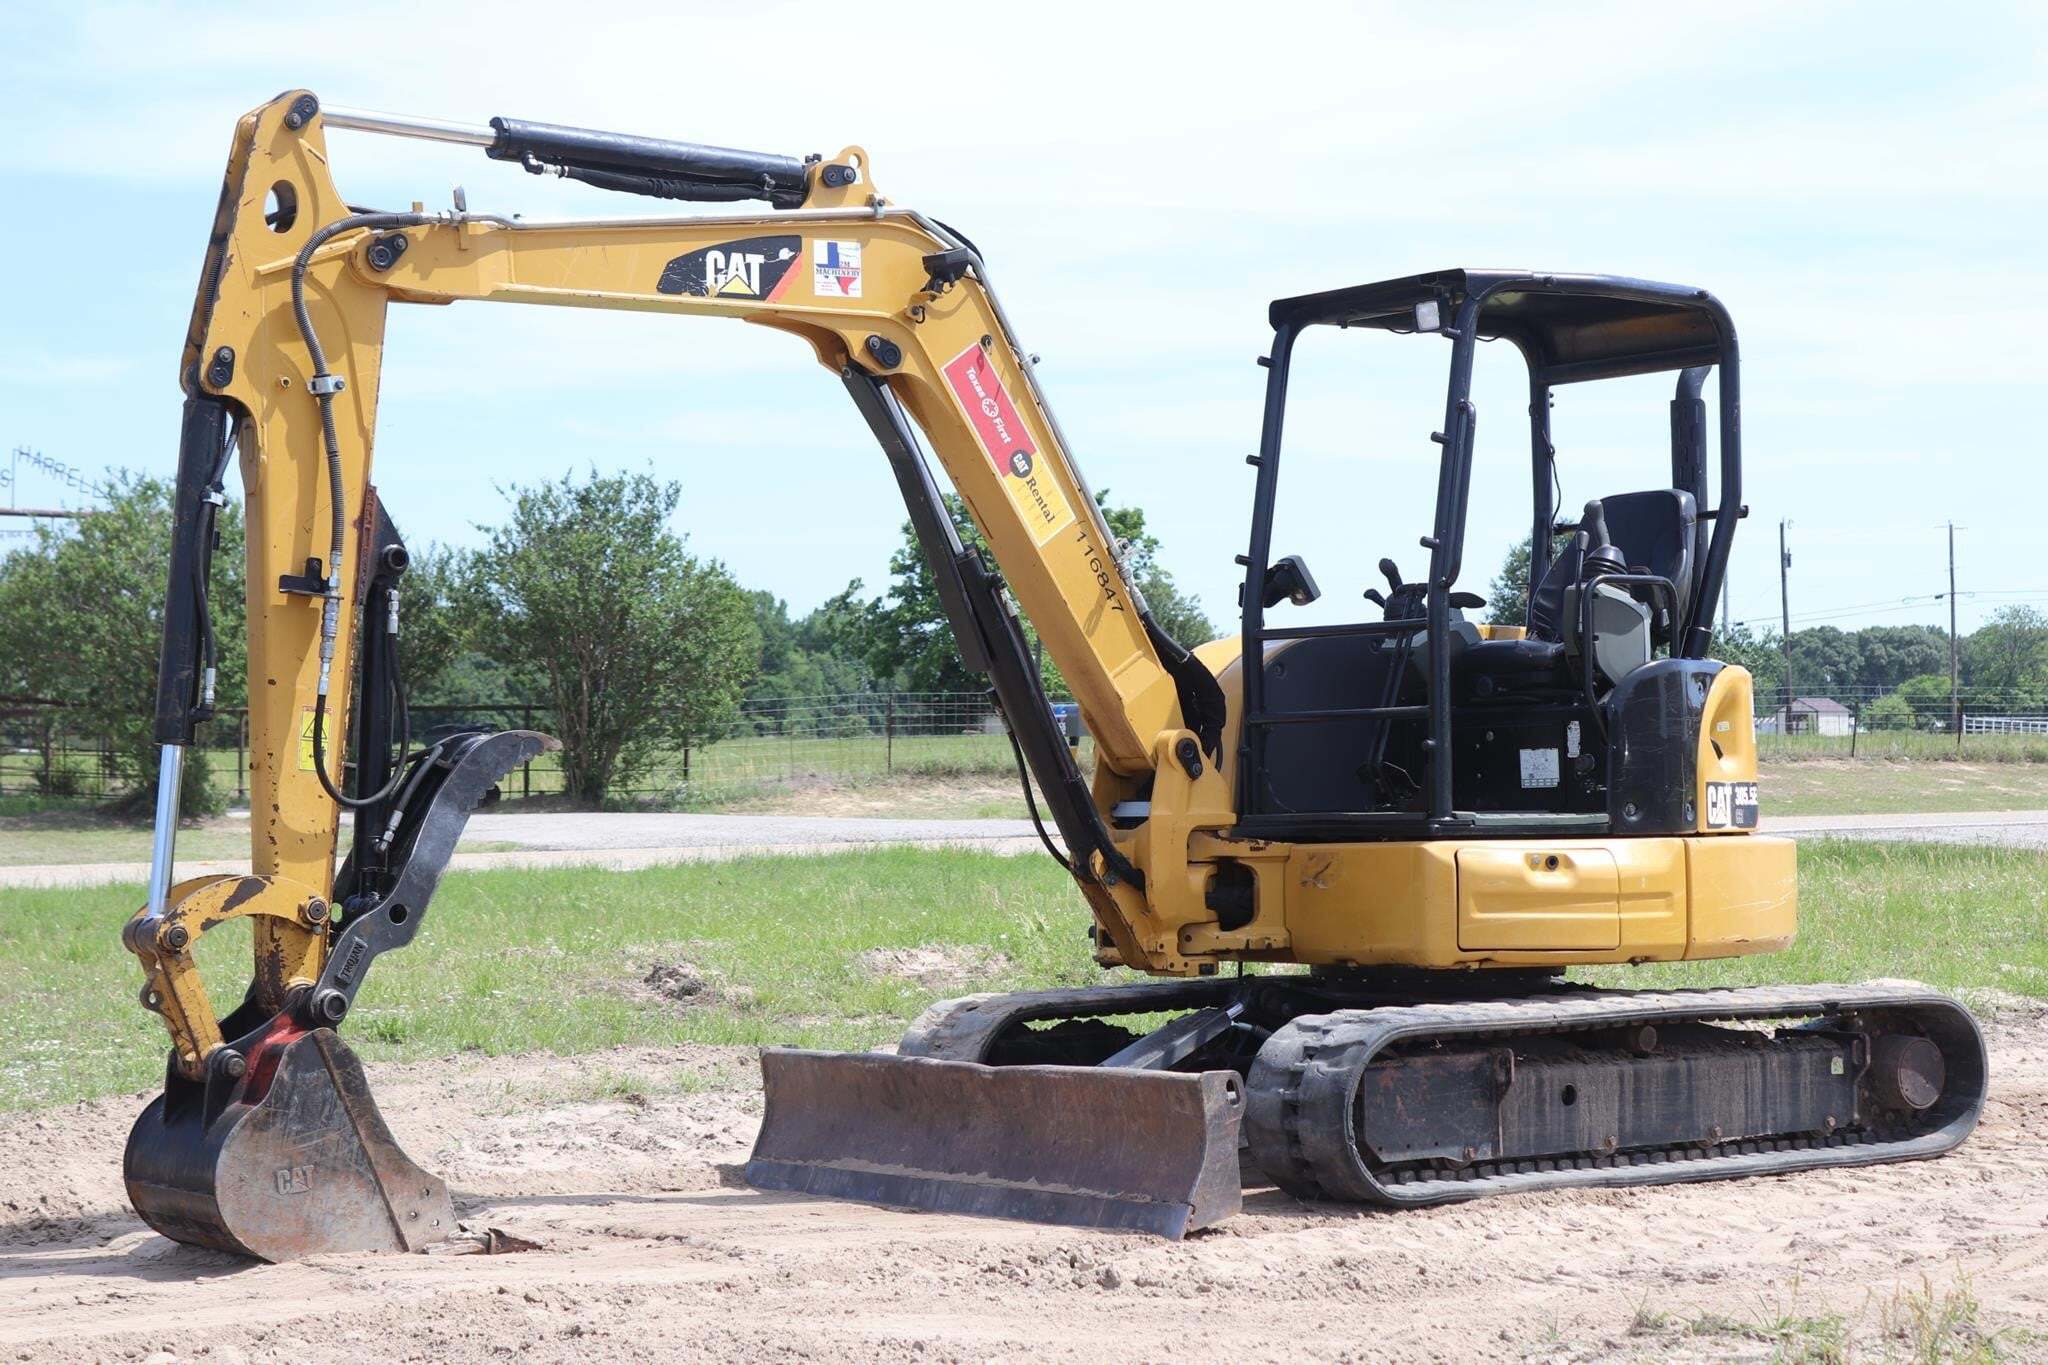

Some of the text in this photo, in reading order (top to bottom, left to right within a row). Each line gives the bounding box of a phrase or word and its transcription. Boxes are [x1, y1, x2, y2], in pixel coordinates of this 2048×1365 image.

[706, 250, 764, 295] CAT
[966, 367, 1012, 445] Texas First
[1012, 453, 1056, 524] CAT Rental
[1077, 530, 1125, 612] 116847
[1707, 785, 1732, 826] CAT
[277, 1164, 315, 1195] CAT
